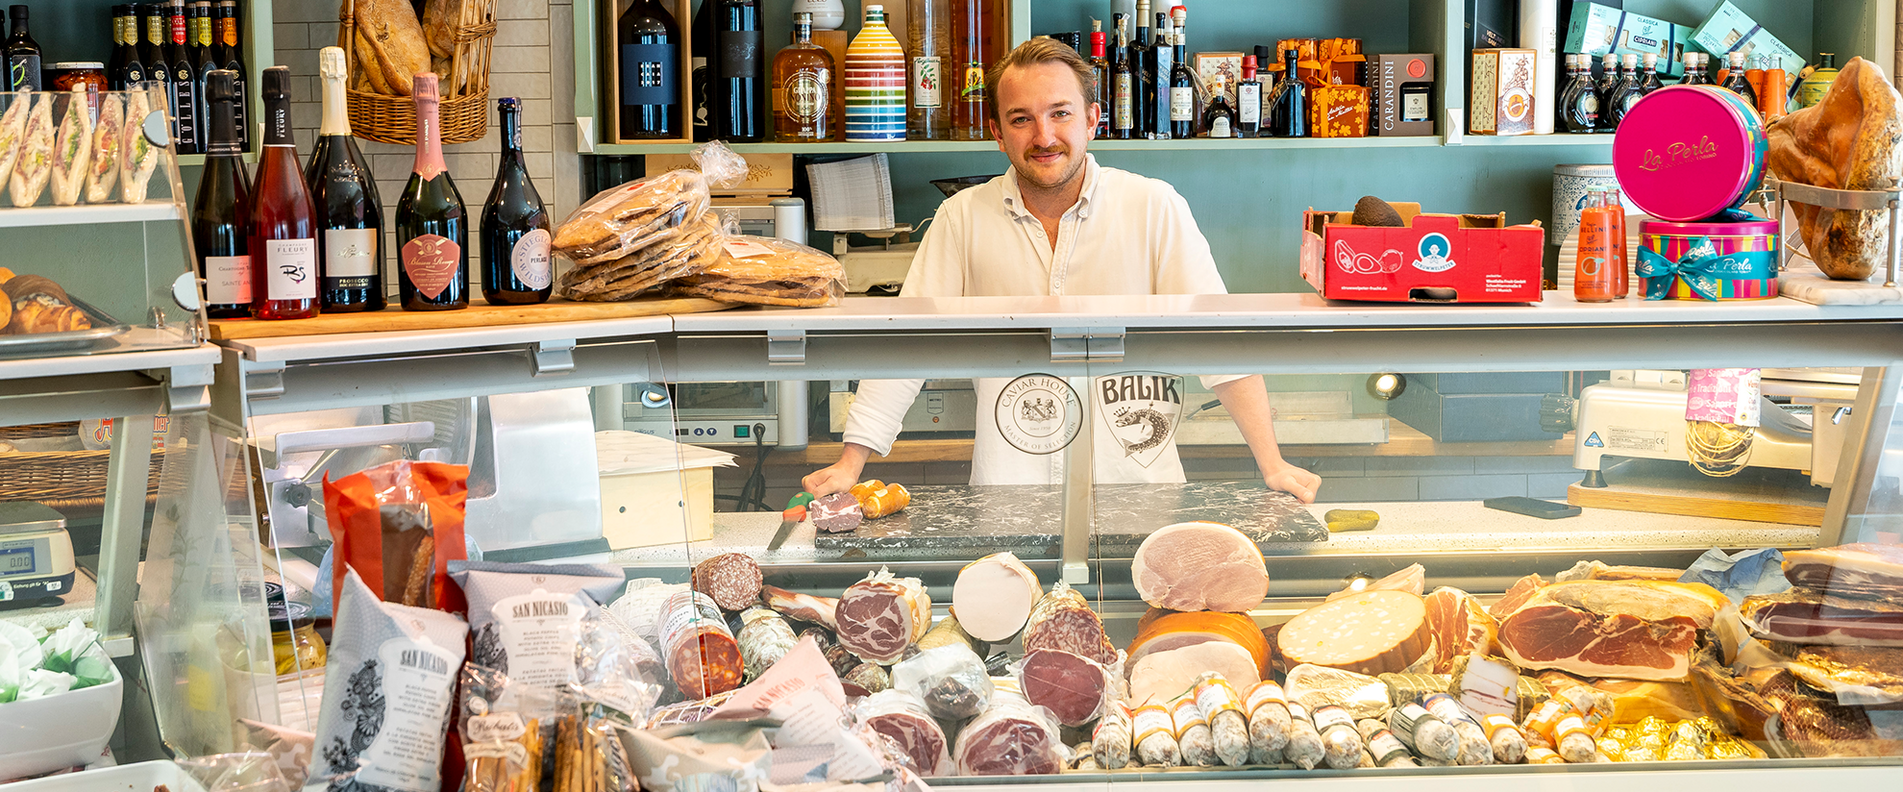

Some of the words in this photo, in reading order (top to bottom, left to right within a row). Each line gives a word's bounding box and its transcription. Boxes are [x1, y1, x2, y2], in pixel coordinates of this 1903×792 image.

[1637, 16, 1659, 27] CLASSICA
[1769, 38, 1793, 58] CLASSICA
[1384, 61, 1394, 131] CARANDINI
[1639, 149, 1664, 172] La
[1667, 135, 1719, 161] Perla
[1414, 261, 1454, 271] STRUWWELPETER
[1722, 258, 1753, 270] Perla
[1002, 378, 1037, 408] CAVIAR
[1041, 378, 1075, 407] HOUSE
[1102, 375, 1181, 405] BALIK
[1004, 425, 1028, 448] MASTER
[1044, 421, 1077, 450] SELECTION
[10, 556, 30, 567] 0.00
[512, 602, 530, 618] SAN
[532, 601, 568, 617] NICASIO
[400, 650, 417, 667] SAN
[418, 651, 448, 676] NICASIO
[766, 677, 806, 700] NICASIO
